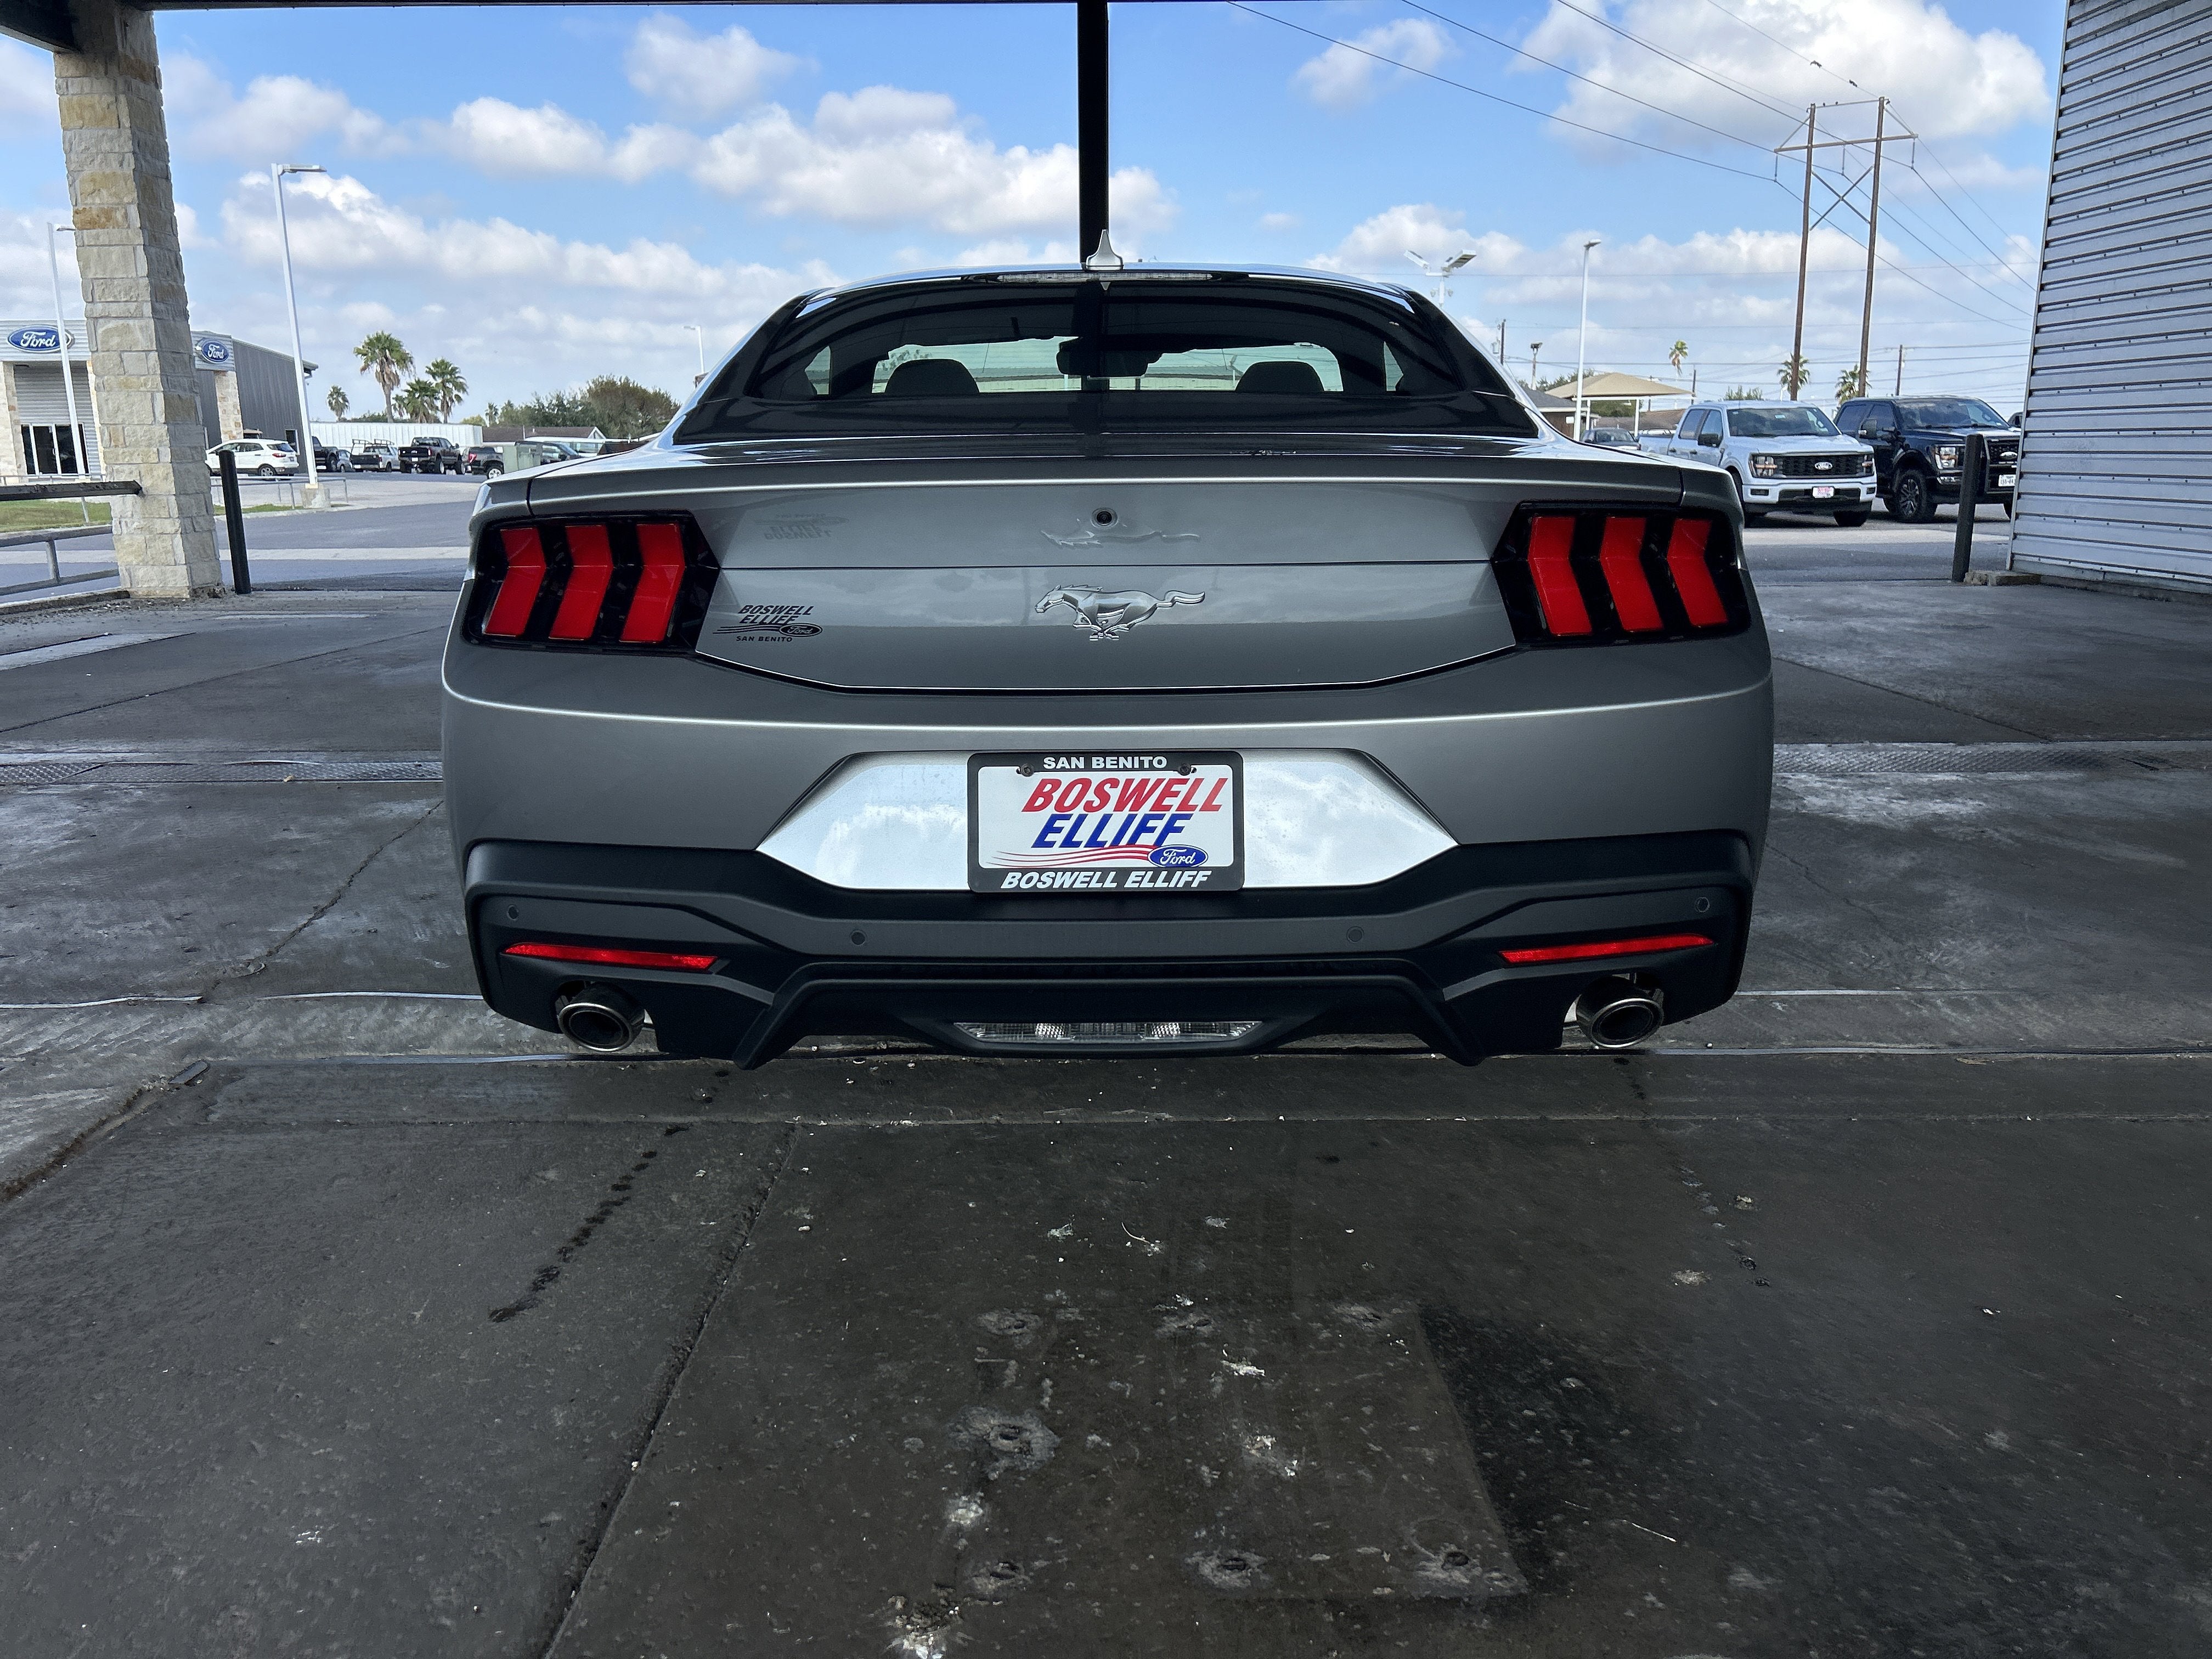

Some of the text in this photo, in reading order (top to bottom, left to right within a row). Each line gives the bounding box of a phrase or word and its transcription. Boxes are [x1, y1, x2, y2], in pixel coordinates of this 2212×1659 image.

[20, 331, 56, 347] Ford
[207, 344, 224, 359] Ford
[737, 605, 814, 616] BOSWELL
[739, 614, 799, 624] ELLIFF
[787, 625, 814, 634] Ford
[1043, 756, 1167, 769] SAN BENITO
[1022, 777, 1228, 812] BOSWELL
[1031, 813, 1194, 848] ELLIFF
[1160, 848, 1197, 865] Ford
[1000, 870, 1212, 889] BOSWELL ELLIFF
